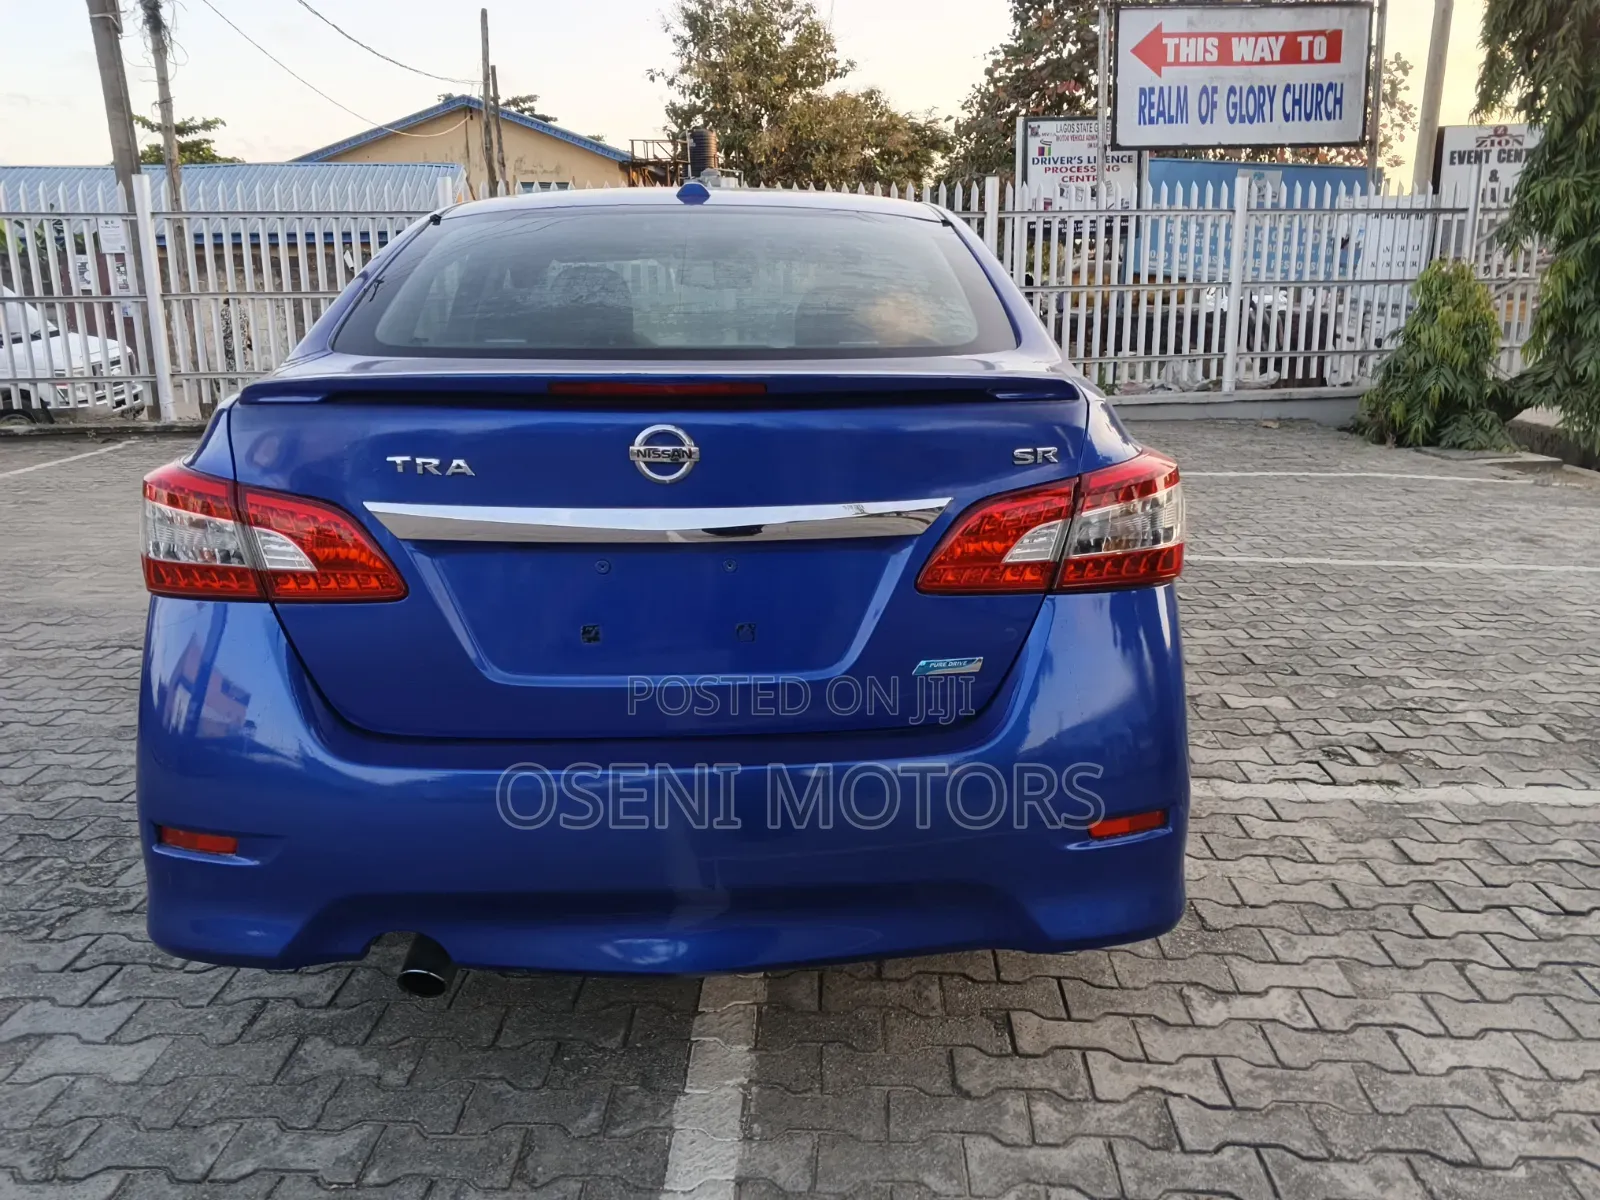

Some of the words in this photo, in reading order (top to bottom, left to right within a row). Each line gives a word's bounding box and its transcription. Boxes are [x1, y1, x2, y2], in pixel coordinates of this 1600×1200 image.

[1162, 37, 1219, 63] THIS
[1231, 35, 1285, 62] WAY
[1297, 35, 1327, 61] TO
[1138, 85, 1189, 126] REALM
[1198, 84, 1218, 125] OF
[1226, 85, 1277, 124] GLORY
[1282, 82, 1344, 122] CHURCH
[1056, 123, 1075, 133] LAGOS
[1076, 122, 1093, 133] STATE
[1476, 135, 1525, 148] ZION
[1032, 155, 1083, 165] DRIVER'S
[1087, 154, 1133, 165] LIENCE
[1449, 149, 1492, 166] EVENT
[1497, 148, 1529, 164] CENT
[1044, 165, 1120, 174] PROCESSNG
[1489, 169, 1499, 182] &
[1061, 174, 1098, 183] CENTR
[636, 448, 693, 460] NISSAN
[1012, 446, 1059, 465] SR
[386, 456, 475, 477] TRA
